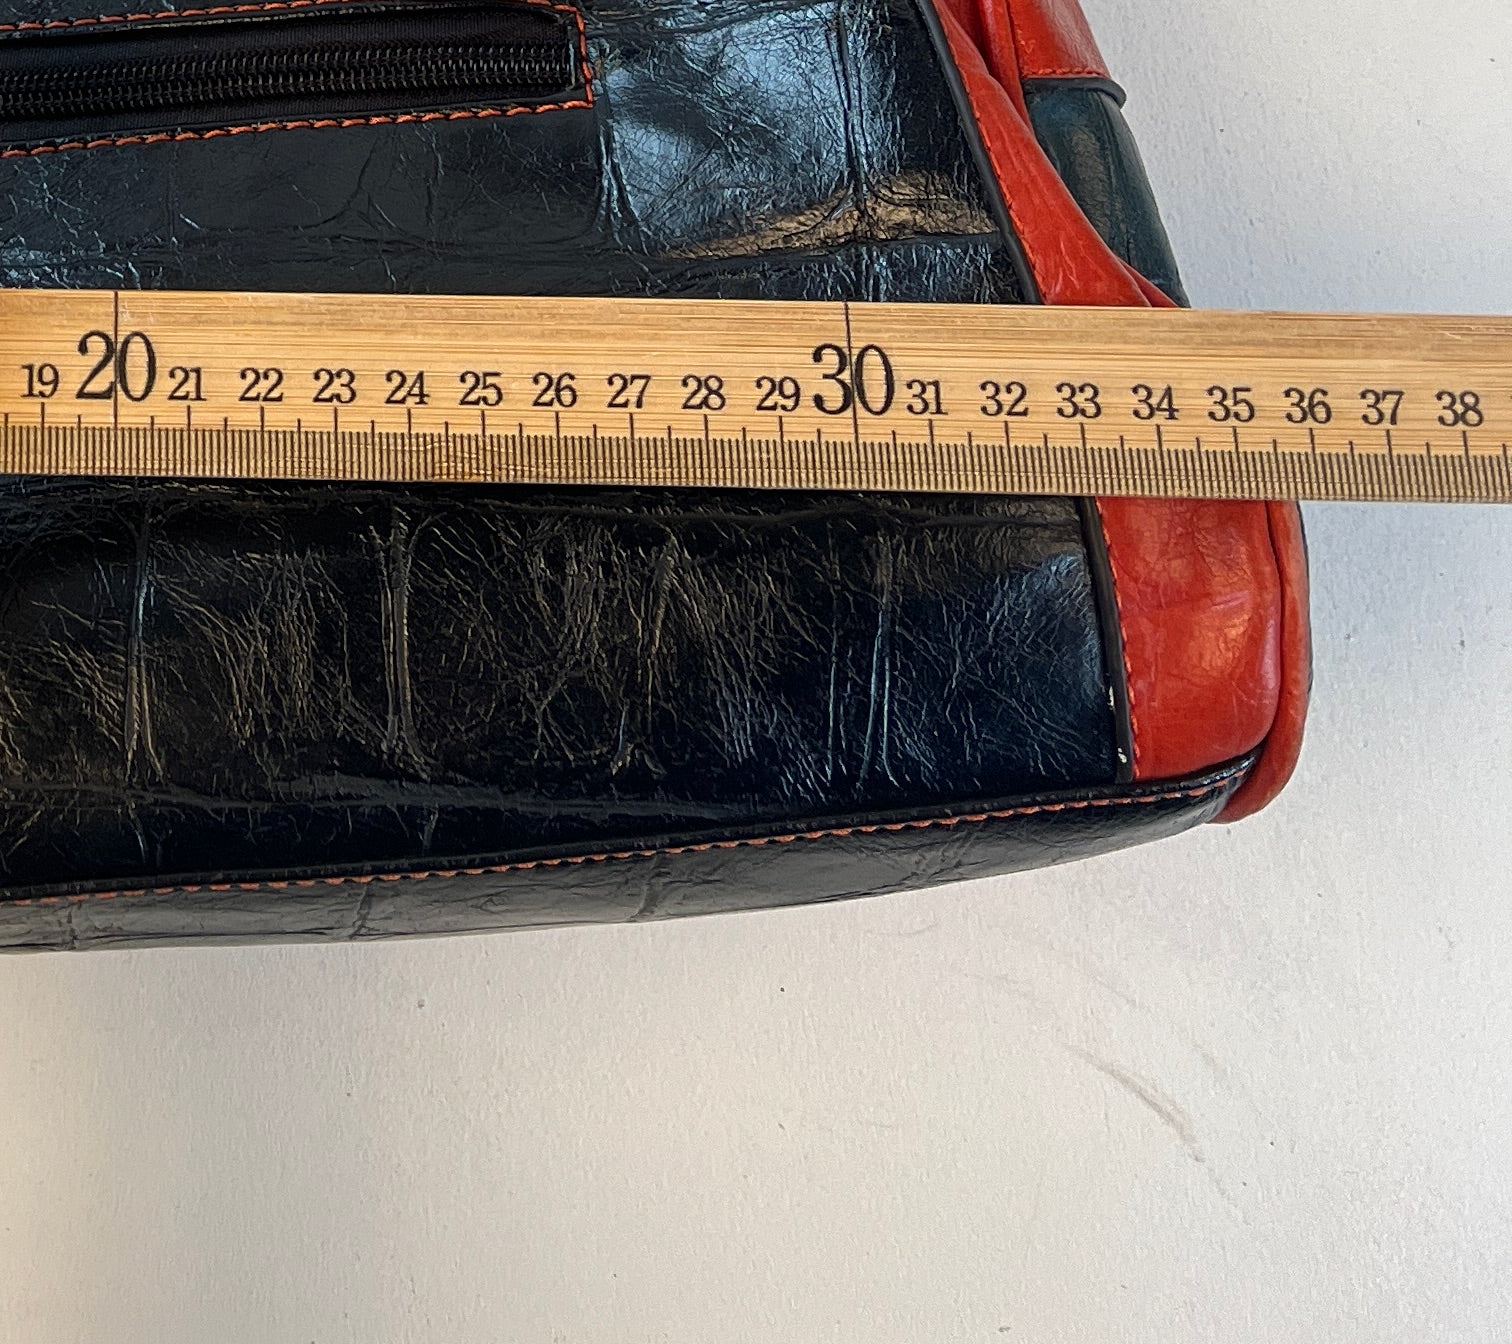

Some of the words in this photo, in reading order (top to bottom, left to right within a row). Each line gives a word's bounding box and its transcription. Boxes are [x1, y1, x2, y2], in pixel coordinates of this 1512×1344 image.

[21, 364, 59, 399] 19
[76, 332, 156, 402] 20
[167, 367, 204, 401] 21
[239, 367, 284, 403] 22
[313, 369, 357, 404] 23
[385, 371, 430, 405] 24
[459, 372, 504, 407] 25
[532, 373, 577, 408] 26
[607, 374, 651, 409] 27
[680, 376, 726, 411] 28
[755, 377, 801, 412] 29
[812, 344, 895, 416] 30
[906, 380, 948, 415] 31
[980, 382, 1029, 416] 32
[1056, 384, 1102, 419] 33
[1132, 385, 1179, 421] 34
[1208, 387, 1255, 422] 35
[1284, 388, 1332, 425] 36
[1360, 390, 1405, 425] 37
[1436, 392, 1485, 427] 38
